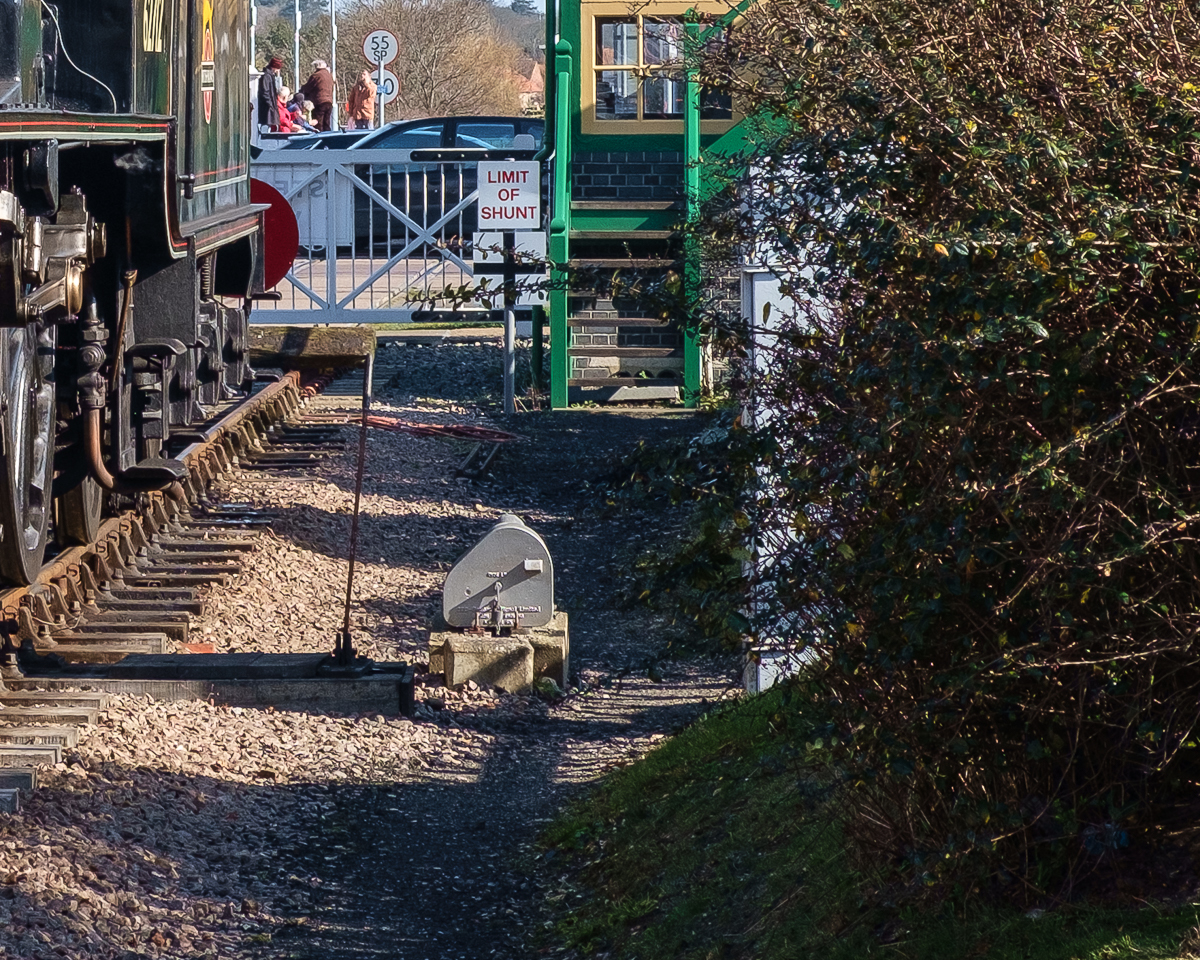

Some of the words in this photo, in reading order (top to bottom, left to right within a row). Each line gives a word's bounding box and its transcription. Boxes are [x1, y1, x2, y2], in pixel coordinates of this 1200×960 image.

[371, 36, 389, 50] 55
[373, 50, 388, 61] SP
[487, 170, 529, 184] LIMIT
[497, 189, 520, 202] OF
[481, 207, 537, 220] SHUNT
